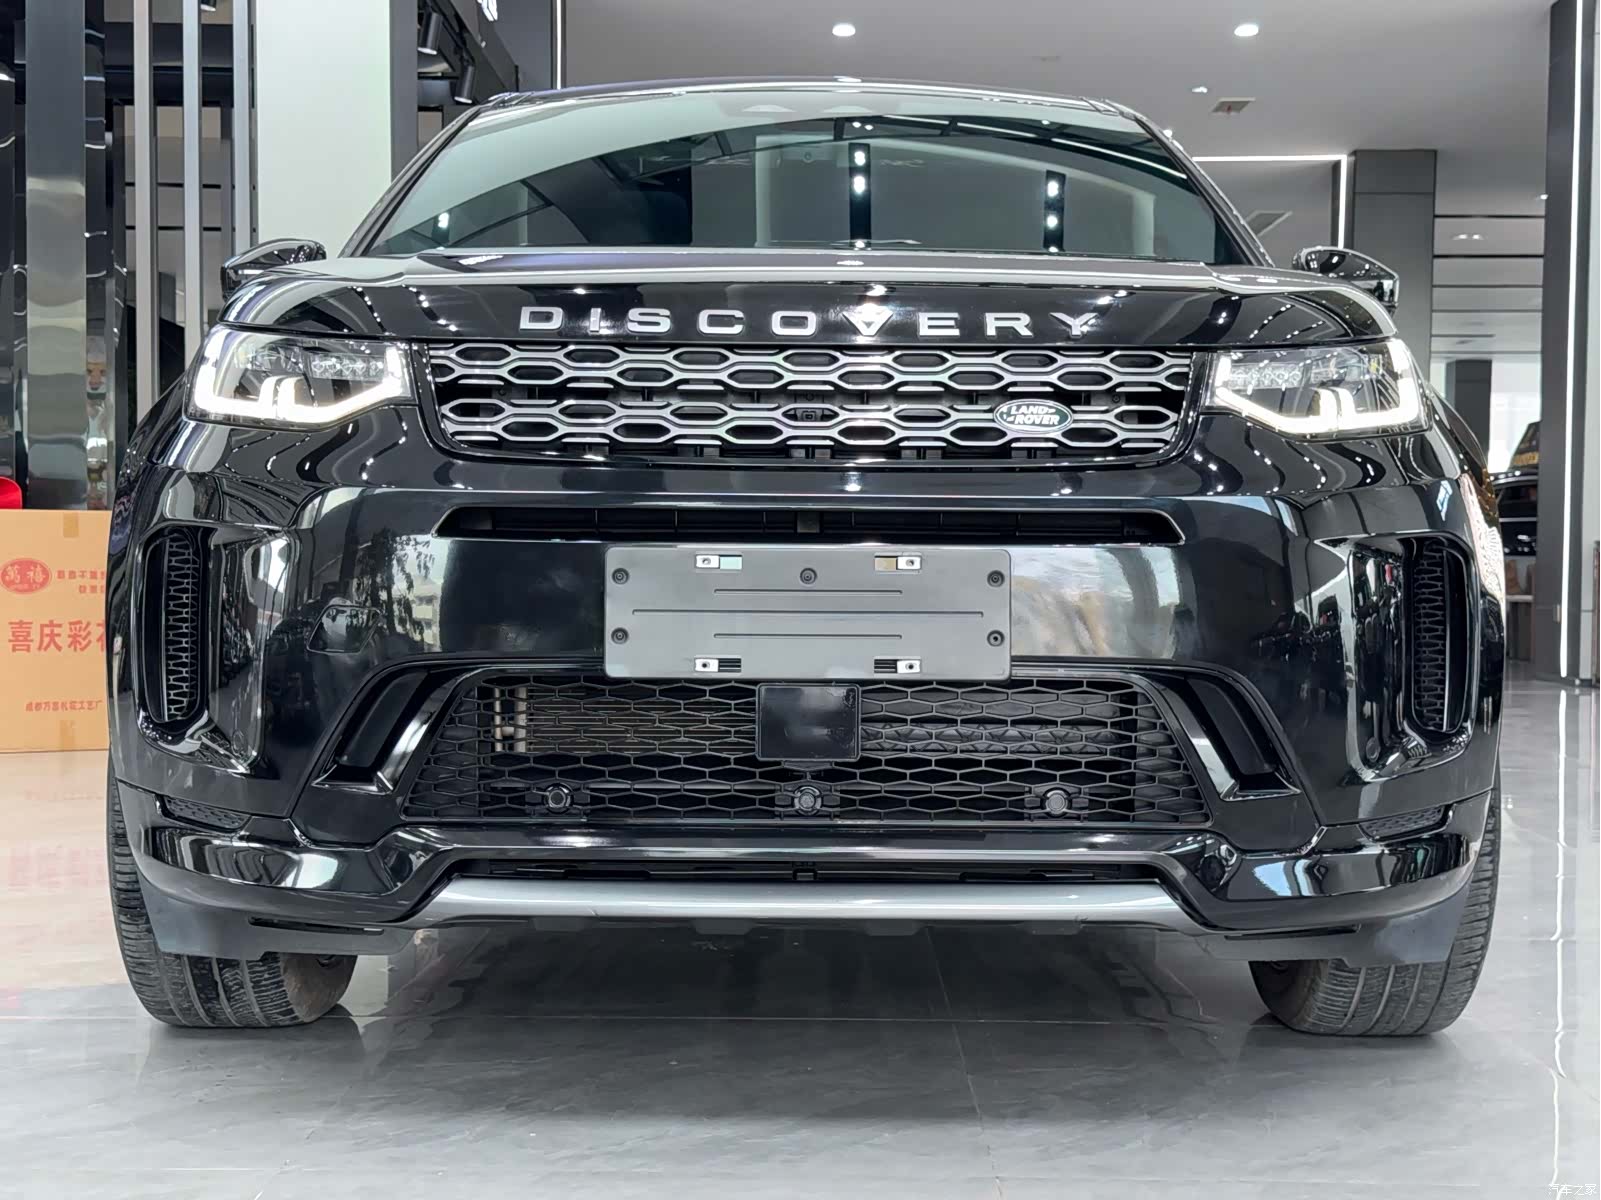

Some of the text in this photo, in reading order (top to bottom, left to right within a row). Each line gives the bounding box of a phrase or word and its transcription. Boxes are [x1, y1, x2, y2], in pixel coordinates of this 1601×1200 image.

[519, 305, 1099, 338] DISCOVERY
[1010, 405, 1050, 415] LAND
[1014, 414, 1061, 425] ROVER
